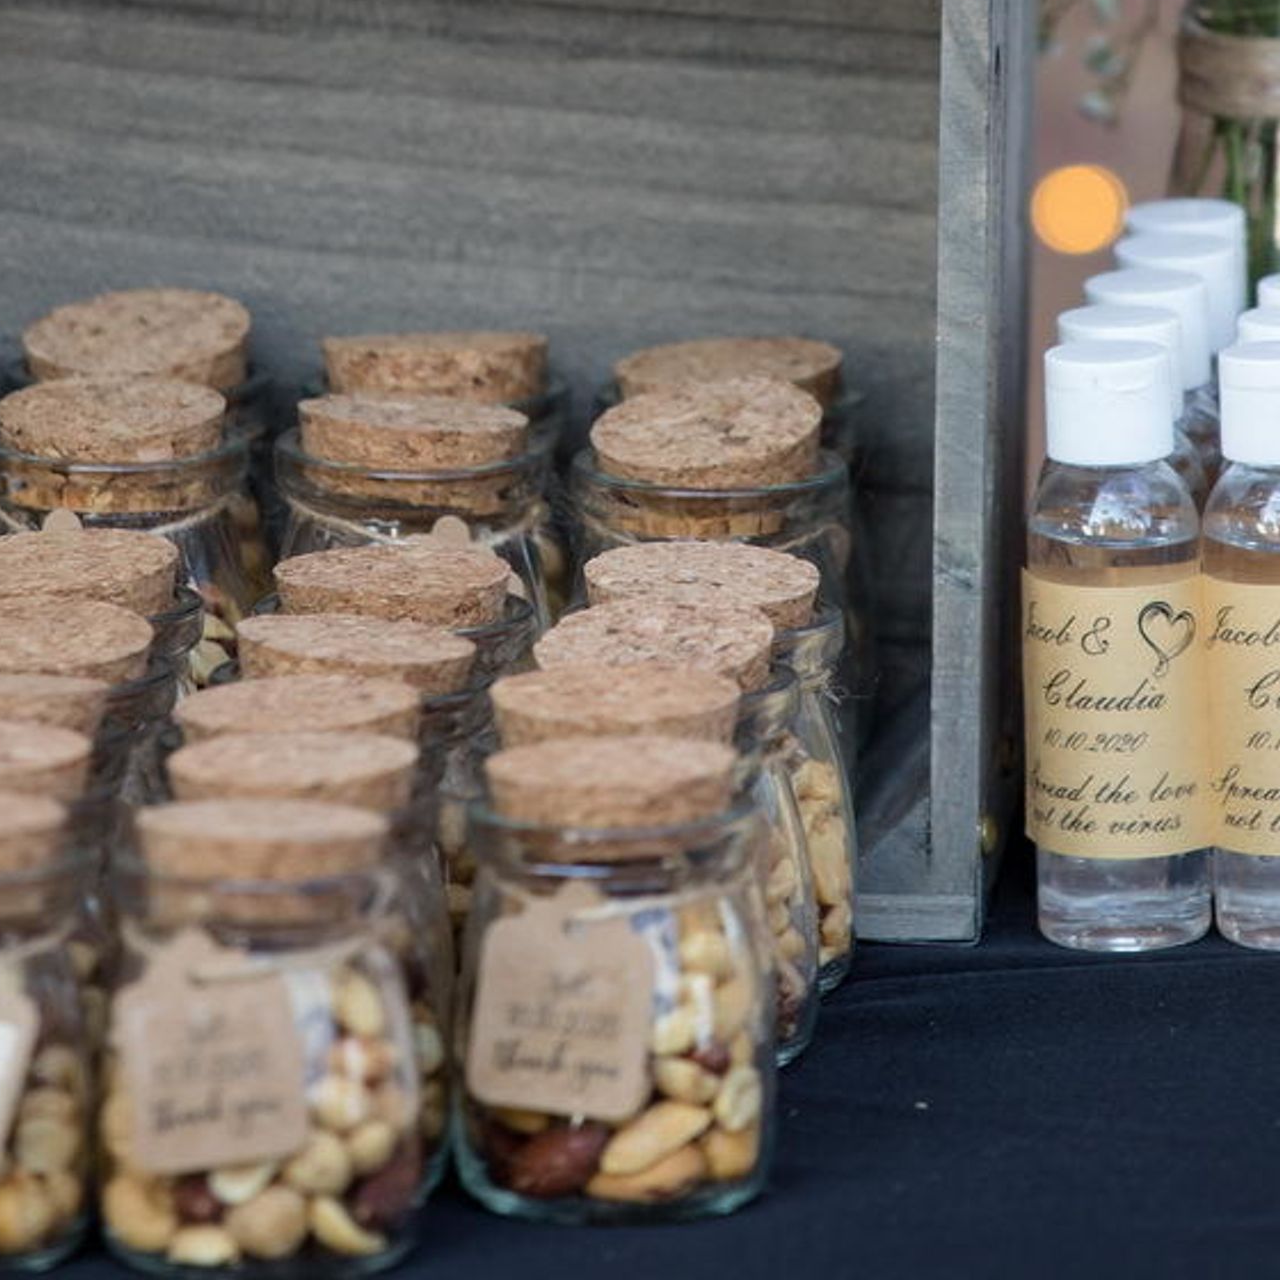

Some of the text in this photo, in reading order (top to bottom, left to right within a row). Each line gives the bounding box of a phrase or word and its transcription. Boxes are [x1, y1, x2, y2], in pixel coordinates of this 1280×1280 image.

[1081, 617, 1110, 655] &
[1042, 669, 1166, 712] Claudia
[1042, 728, 1150, 753] 10.10.2020
[1094, 774, 1139, 804] the
[1148, 771, 1197, 802] love
[1060, 804, 1098, 834] the
[1109, 814, 1182, 835] virus
[1224, 810, 1262, 831] not
